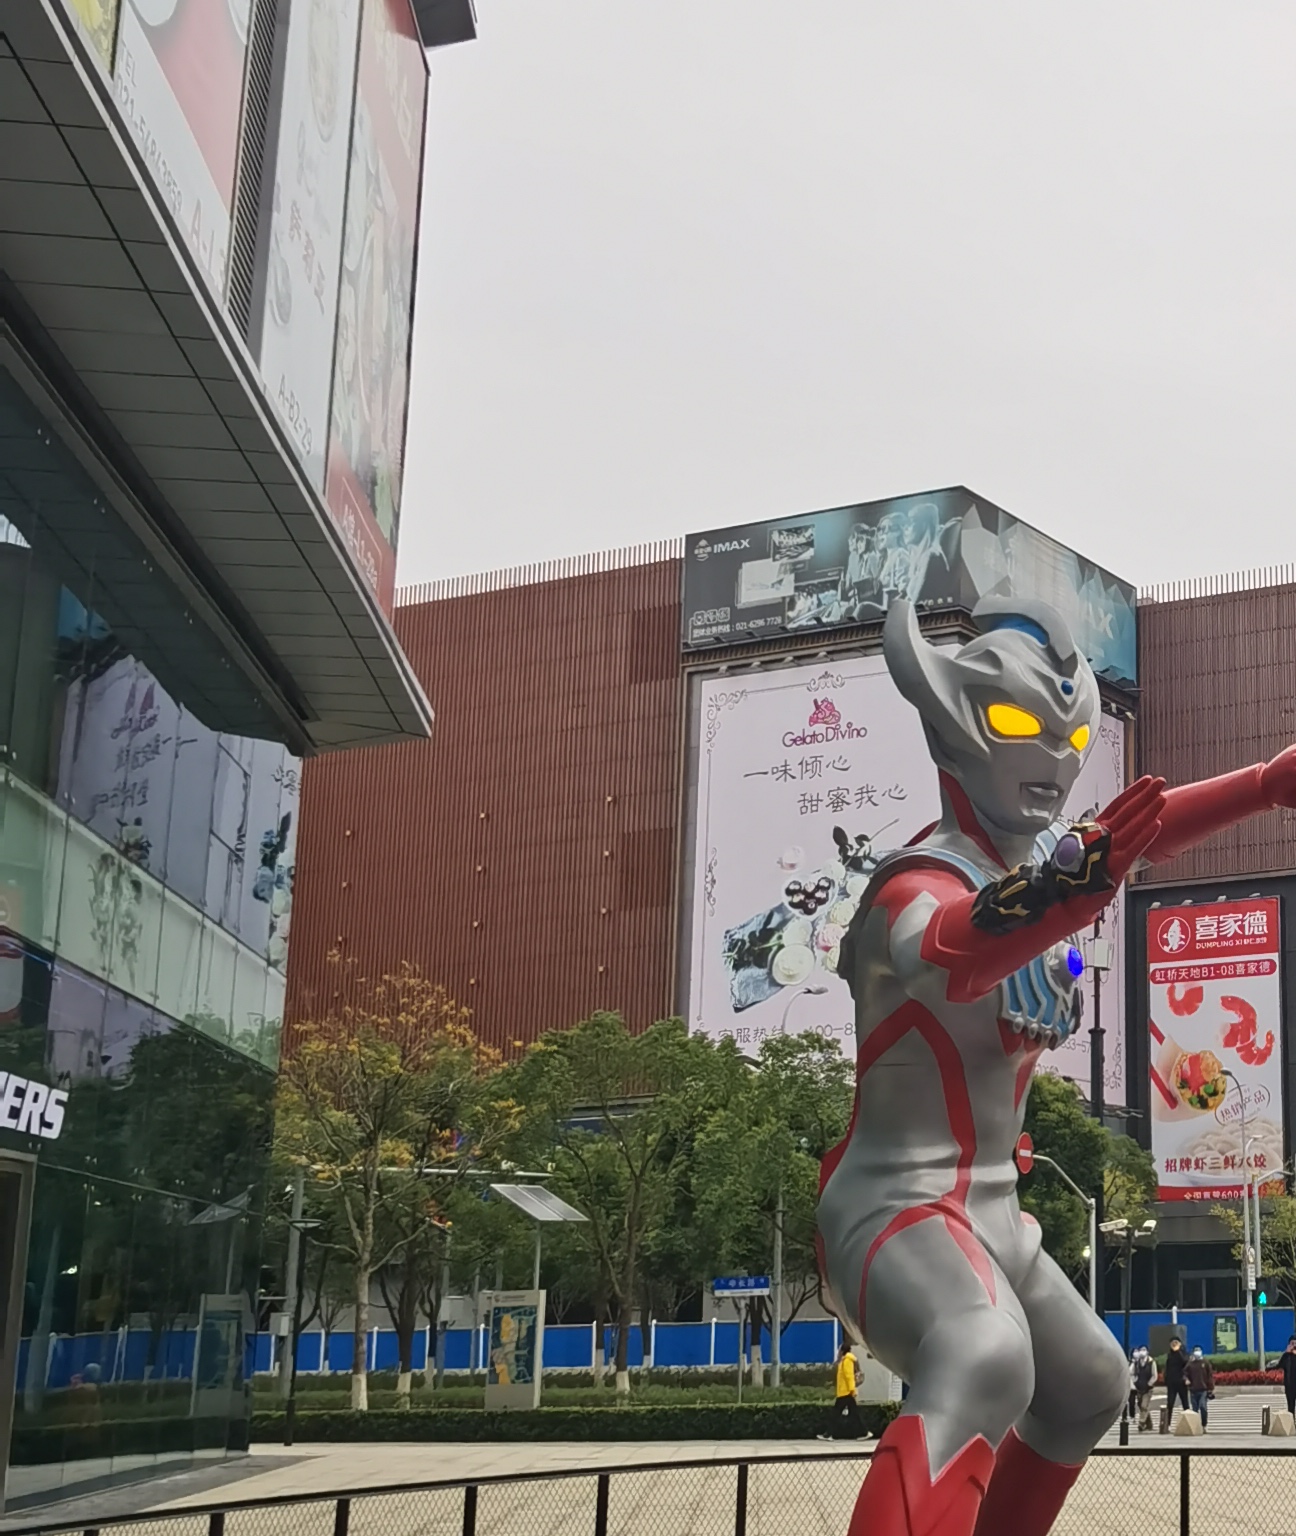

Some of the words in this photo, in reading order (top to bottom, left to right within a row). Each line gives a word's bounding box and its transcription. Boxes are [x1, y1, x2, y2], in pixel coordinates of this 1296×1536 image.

[713, 538, 751, 554] IMAX
[743, 755, 852, 783] 一味倾心
[797, 783, 908, 816] 甜蜜我心
[1195, 910, 1268, 941] 喜家德
[1195, 940, 1234, 950] DUMPLING
[1155, 961, 1271, 982] 虹桥天地B1-08喜家德
[1165, 1152, 1267, 1173] 招牌虾三鲜水饺
